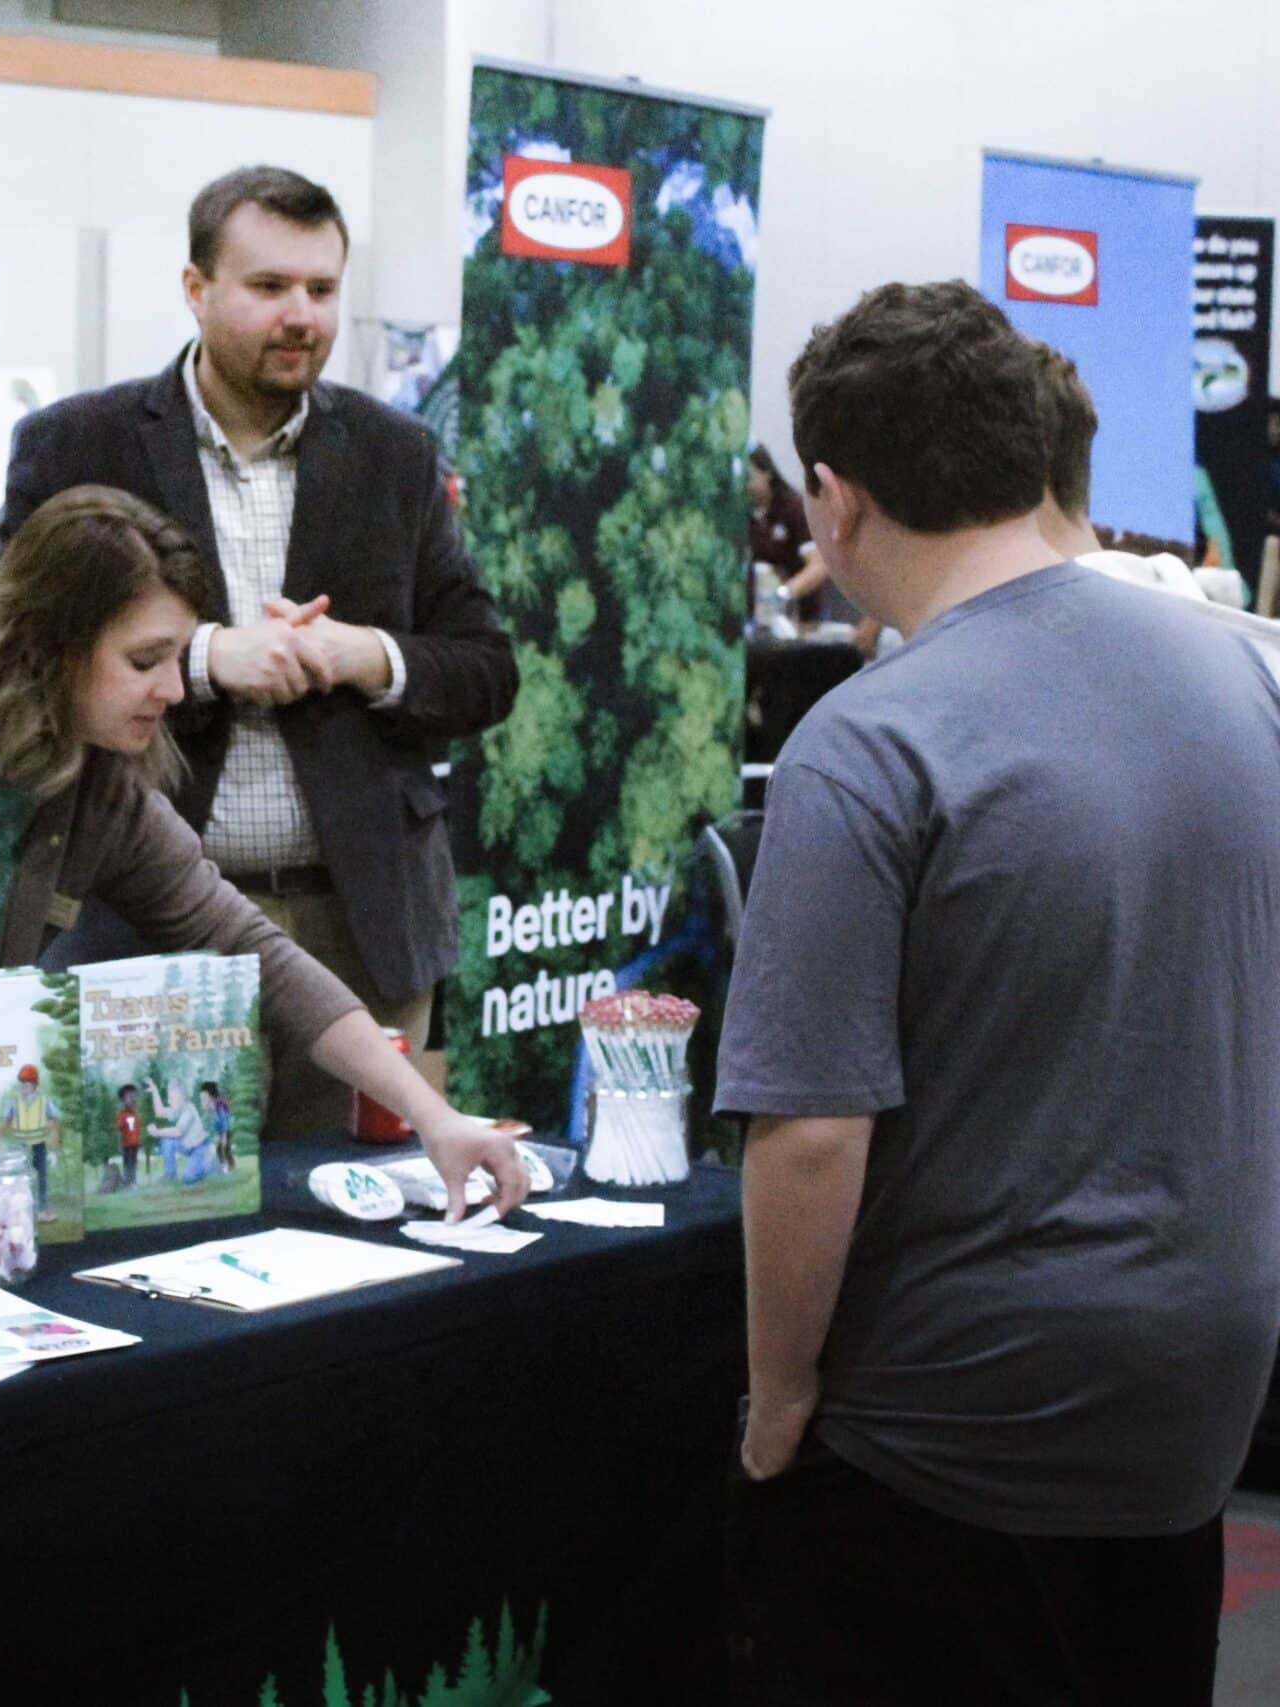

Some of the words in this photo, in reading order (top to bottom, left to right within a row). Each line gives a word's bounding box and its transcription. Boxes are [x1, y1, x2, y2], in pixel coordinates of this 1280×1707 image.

[524, 193, 607, 228] CANFOR
[1023, 251, 1081, 277] CANFOR
[487, 888, 614, 958] Better
[622, 875, 670, 946] by
[85, 990, 188, 1021] Travis
[482, 969, 616, 1037] nature
[85, 1028, 160, 1059] Tree
[169, 1023, 253, 1052] Farm
